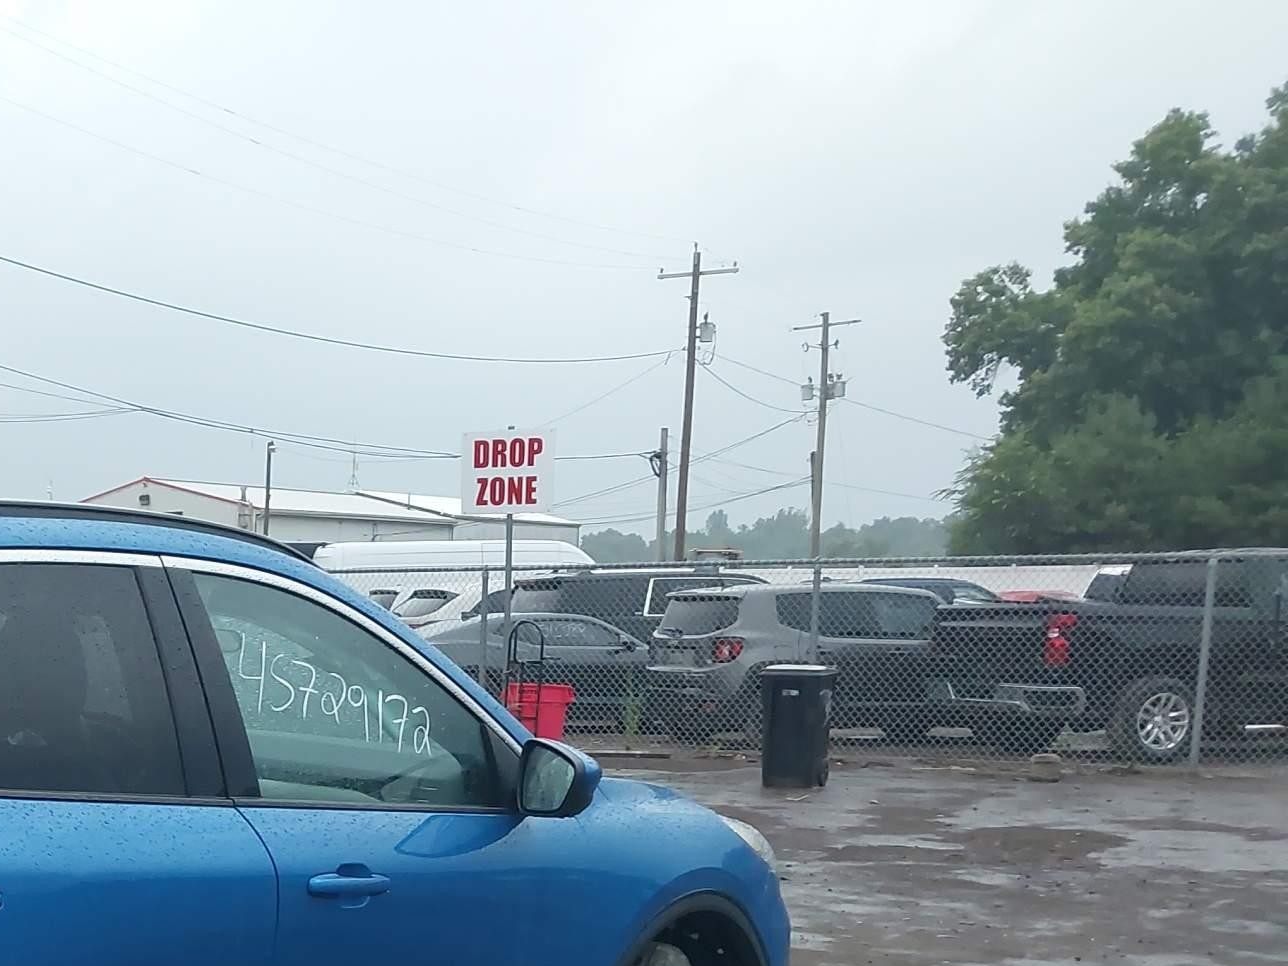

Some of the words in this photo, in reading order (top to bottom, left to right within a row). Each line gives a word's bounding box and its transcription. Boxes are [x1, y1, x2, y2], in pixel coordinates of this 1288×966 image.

[473, 437, 543, 469] DROP
[475, 475, 538, 507] ZONE
[238, 632, 433, 758] 45729172
